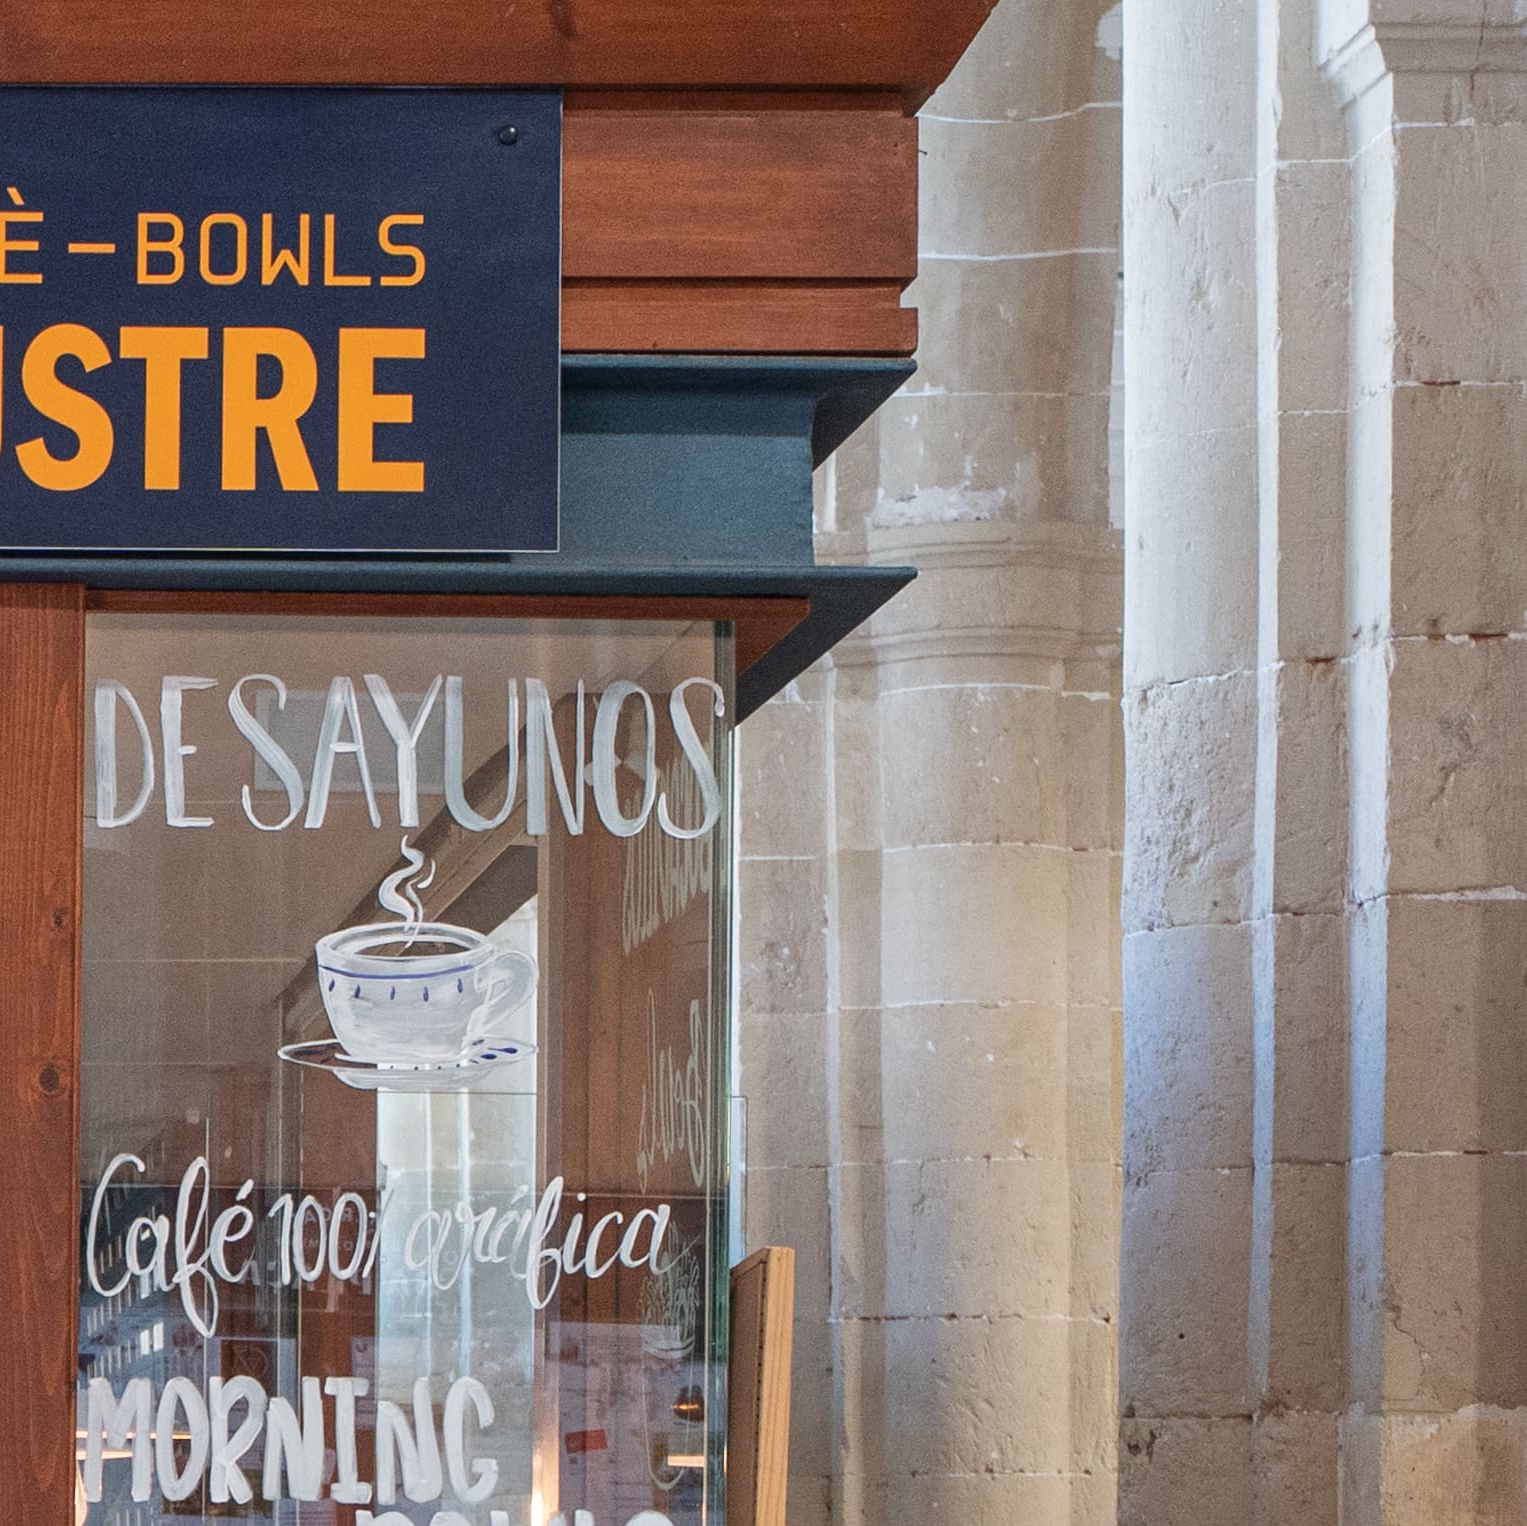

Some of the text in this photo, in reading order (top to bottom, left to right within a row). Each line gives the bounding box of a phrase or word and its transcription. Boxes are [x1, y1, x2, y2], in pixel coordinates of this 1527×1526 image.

[93, 673, 726, 840] DESAYUNOS
[85, 1152, 257, 1339] Café
[83, 1375, 499, 1505] MORNING
